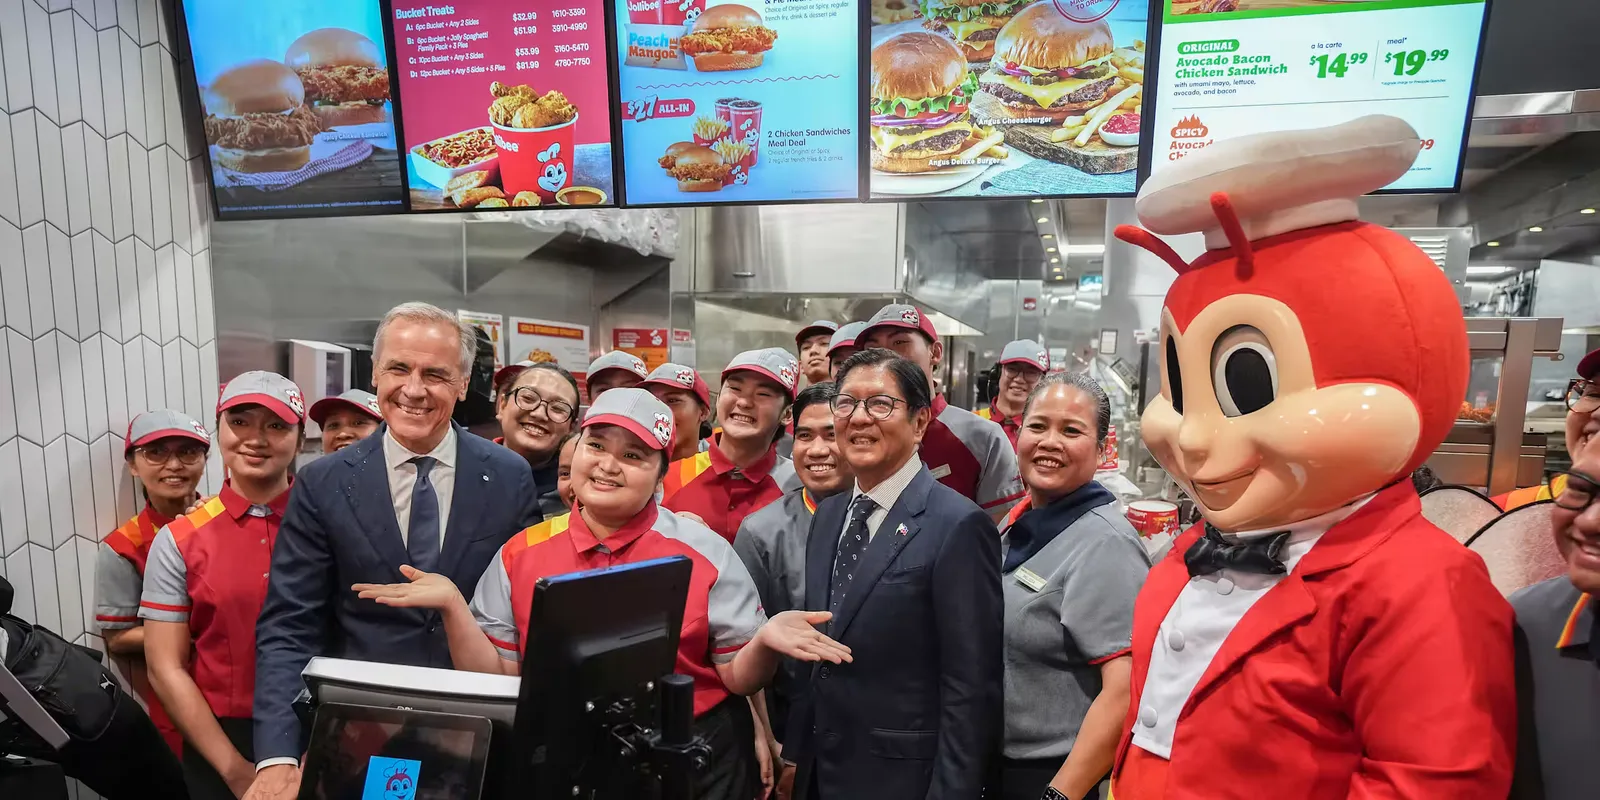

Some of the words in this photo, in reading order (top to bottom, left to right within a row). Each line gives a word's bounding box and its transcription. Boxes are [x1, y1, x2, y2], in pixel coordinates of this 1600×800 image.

[628, 1, 660, 12] Jollibee
[396, 8, 426, 19] Bucket
[426, 5, 454, 16] Treats
[512, 12, 537, 22] $32.99
[514, 26, 537, 36] $51.99
[552, 22, 588, 32] 3910-4990
[463, 31, 488, 41] Spaghetti
[629, 32, 668, 47] Peach
[515, 47, 540, 57] $53.99
[1183, 42, 1234, 52] ORIGINAL
[629, 46, 669, 61] Mango
[516, 61, 539, 70] $81.99
[1176, 56, 1229, 67] Avocado
[1232, 54, 1271, 64] Bacon
[1309, 52, 1368, 78] $14.99
[1384, 49, 1449, 75] $19.99
[1175, 67, 1224, 79] Chicken
[1227, 63, 1288, 76] Sandwich
[628, 94, 658, 122] $27
[659, 103, 689, 114] ALL-IN
[1002, 116, 1052, 124] Cheeseburger
[774, 130, 804, 138] Chicken
[806, 128, 851, 136] Sandwiches
[1175, 128, 1204, 136] SPICY
[1170, 139, 1213, 150] Avoca
